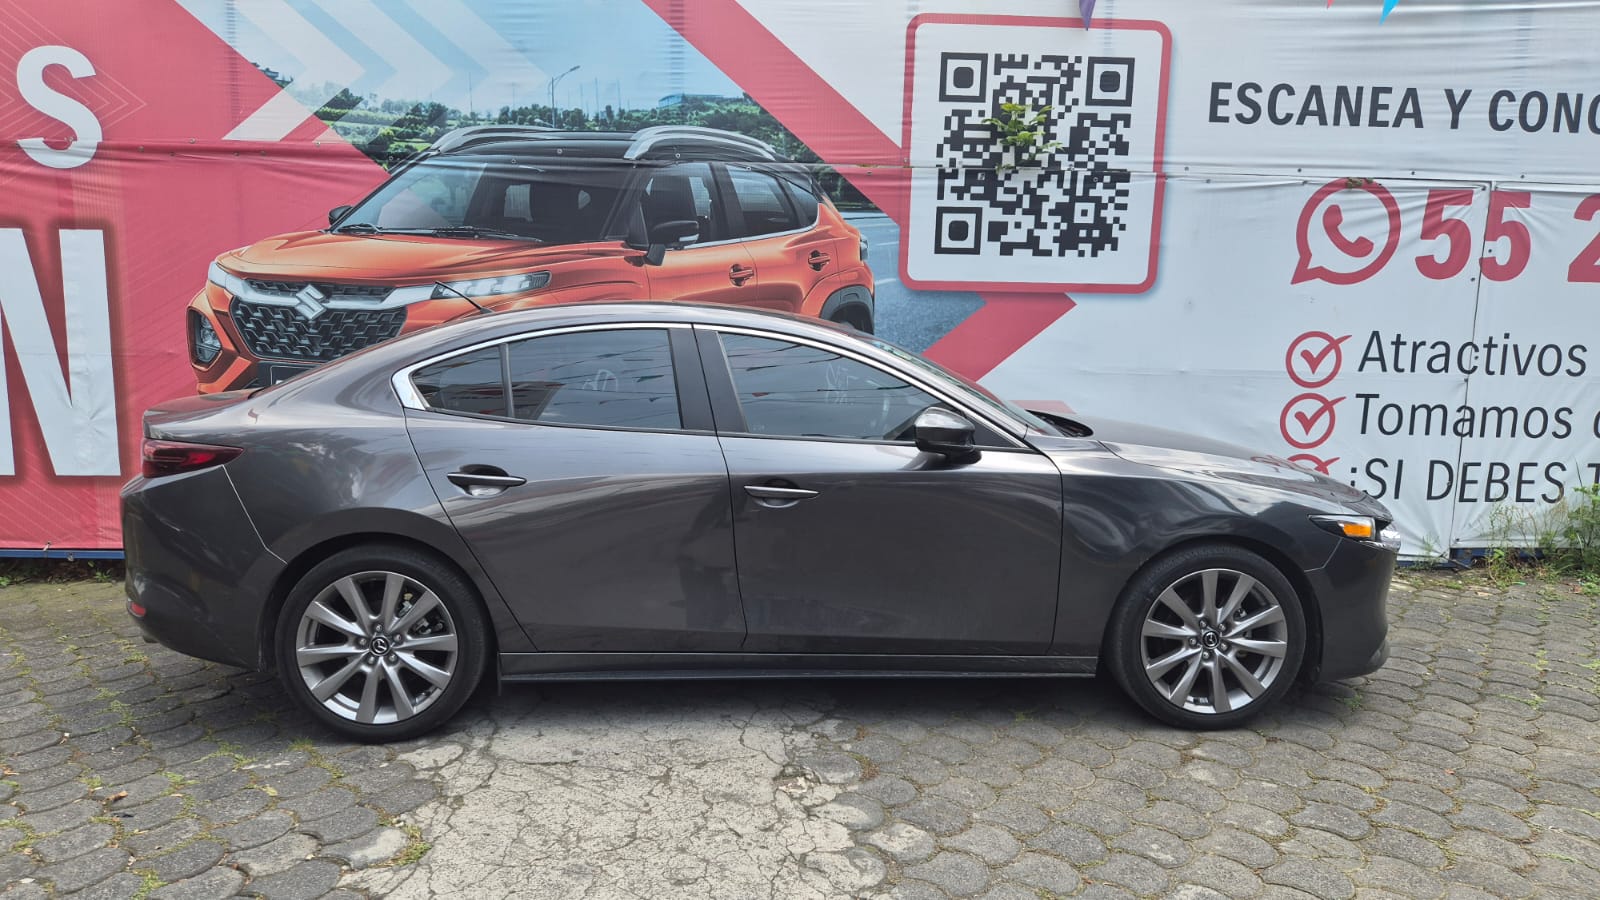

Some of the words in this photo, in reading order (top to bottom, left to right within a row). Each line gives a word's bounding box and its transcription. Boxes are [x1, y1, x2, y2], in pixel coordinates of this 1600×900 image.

[16, 44, 102, 169] S
[1208, 81, 1425, 129] ESCANEA
[1444, 88, 1473, 130] Y
[1414, 187, 1532, 282] 55
[1357, 330, 1588, 377] Atractivos
[1355, 393, 1574, 439] Tomamos
[1426, 459, 1568, 504] DEBES
